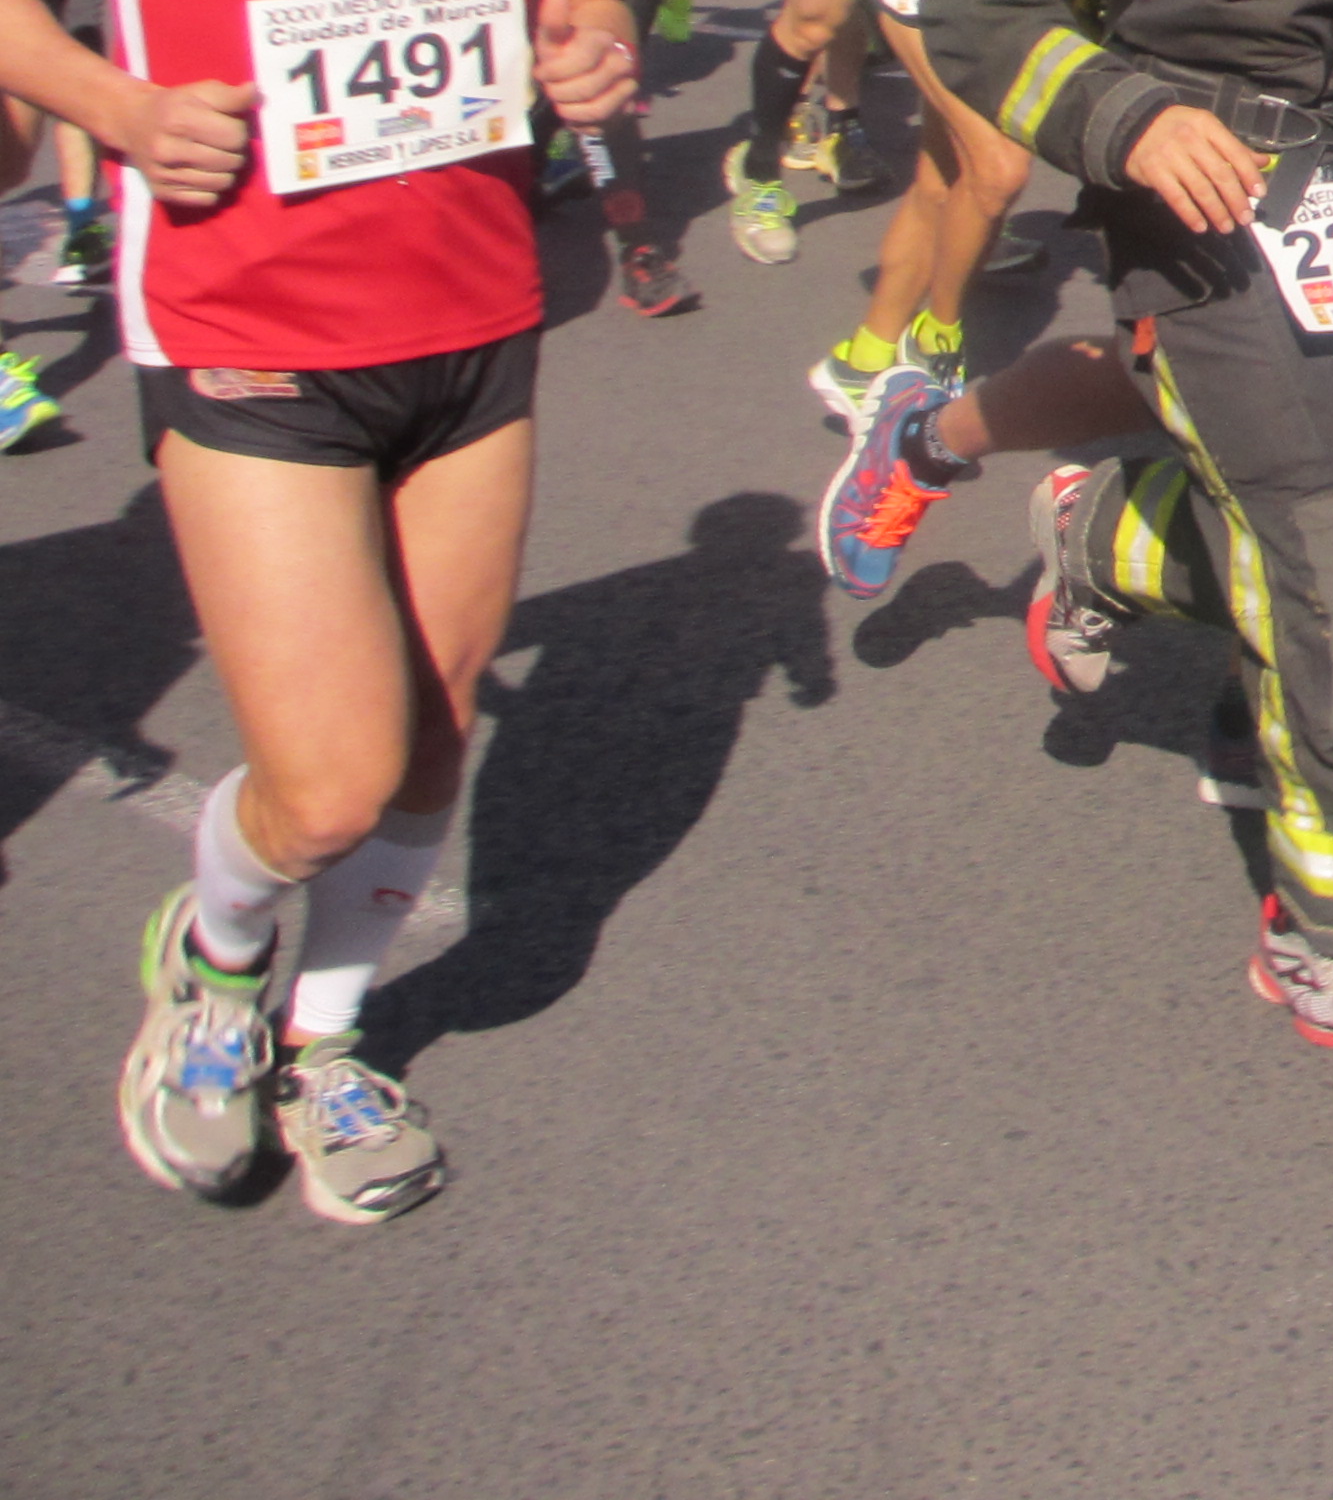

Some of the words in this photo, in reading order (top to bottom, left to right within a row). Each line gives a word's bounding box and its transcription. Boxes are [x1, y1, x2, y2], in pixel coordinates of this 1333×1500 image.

[266, 2, 326, 26] XXXV
[268, 17, 369, 46] Ciudad
[380, 11, 411, 31] de
[287, 22, 497, 115] 1491
